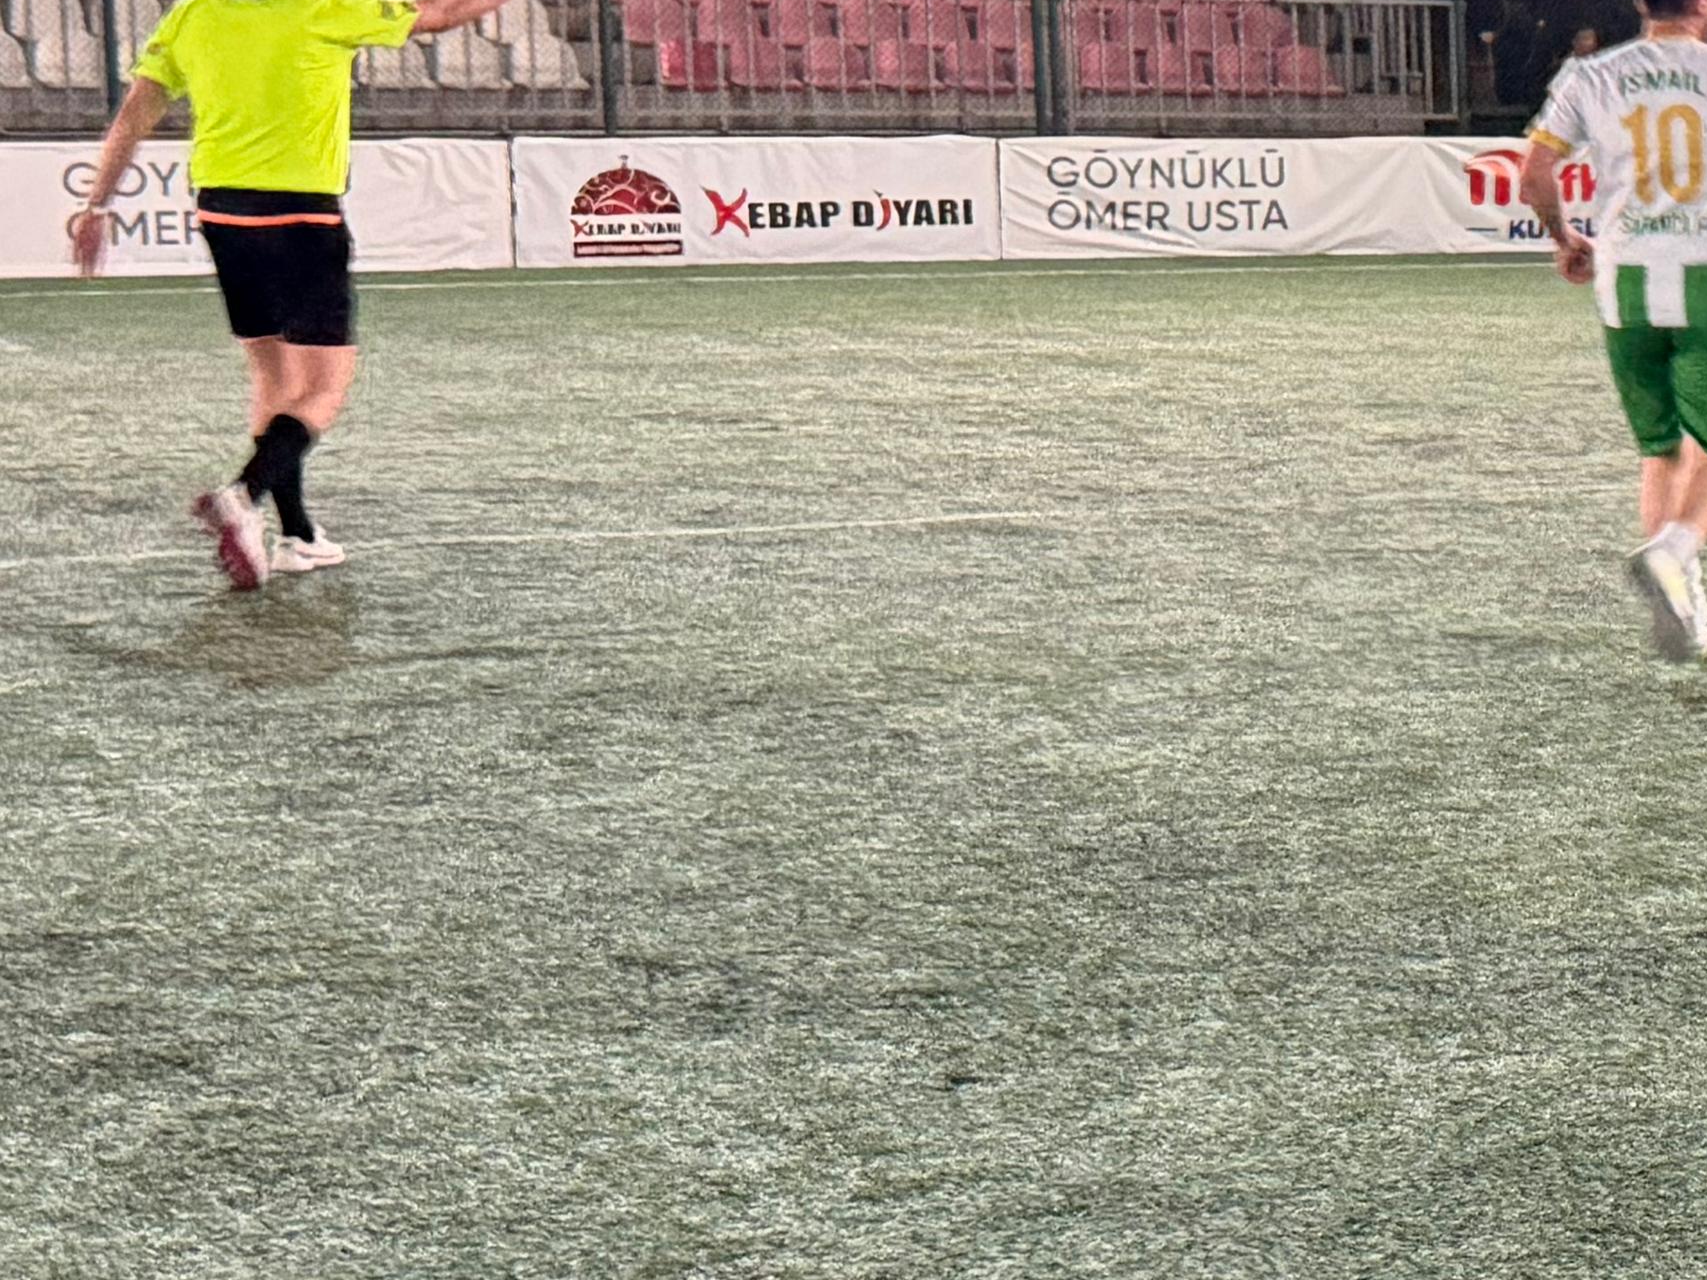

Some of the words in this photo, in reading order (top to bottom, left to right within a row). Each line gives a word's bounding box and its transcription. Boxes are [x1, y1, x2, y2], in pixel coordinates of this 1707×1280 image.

[1047, 149, 1286, 189] GÖYNÜKLÜ
[1620, 103, 1706, 205] 10
[699, 184, 840, 238] KEBAP
[1047, 191, 1170, 231] ÖMER
[1187, 199, 1289, 232] USTA
